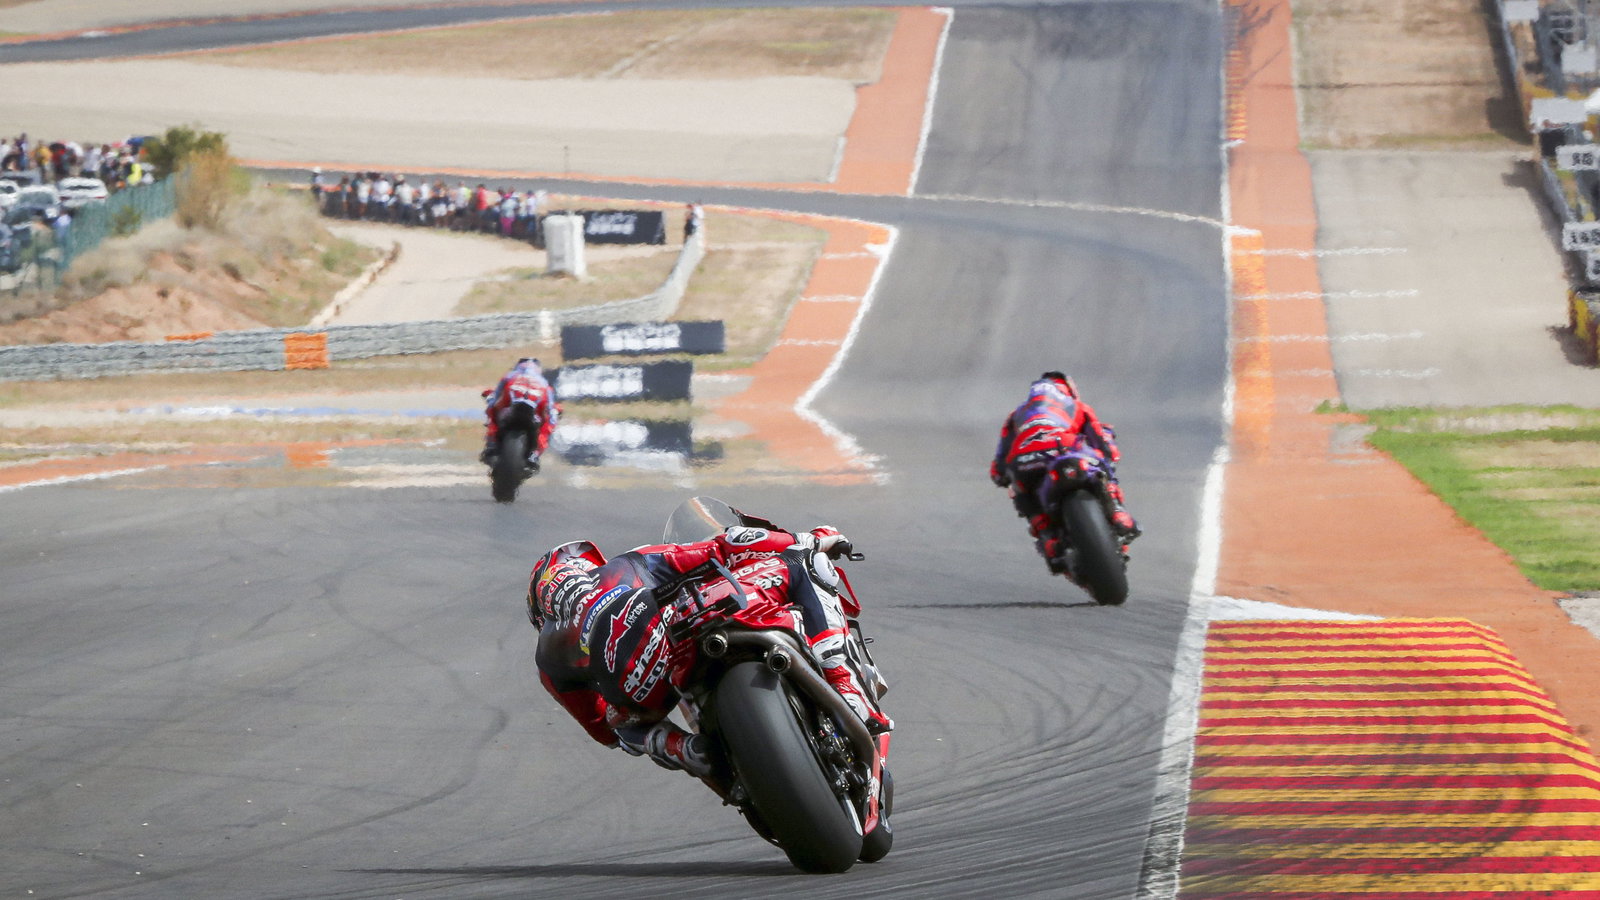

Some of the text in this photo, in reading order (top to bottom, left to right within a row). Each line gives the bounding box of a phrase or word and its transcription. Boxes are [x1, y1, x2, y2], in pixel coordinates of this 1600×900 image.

[573, 587, 603, 627] MOTUL
[586, 588, 622, 630] MICHELIN
[632, 657, 668, 702] aco
